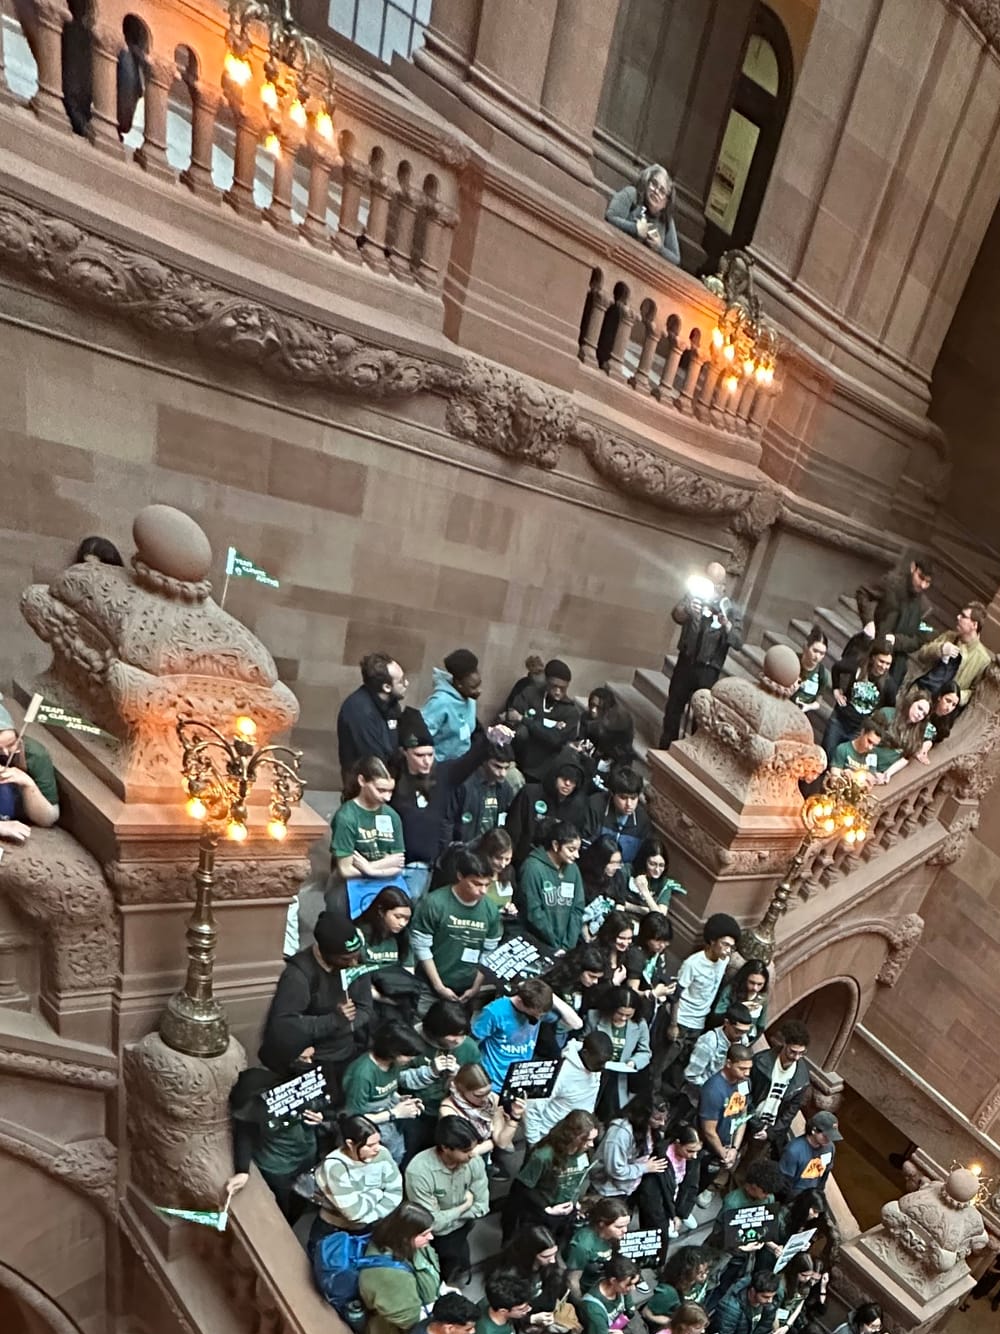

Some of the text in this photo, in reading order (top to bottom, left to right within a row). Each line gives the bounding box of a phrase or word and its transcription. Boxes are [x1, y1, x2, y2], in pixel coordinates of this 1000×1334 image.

[40, 705, 64, 714] TEAM
[48, 713, 82, 724] CLIMATE
[66, 722, 100, 735] JUSTICE
